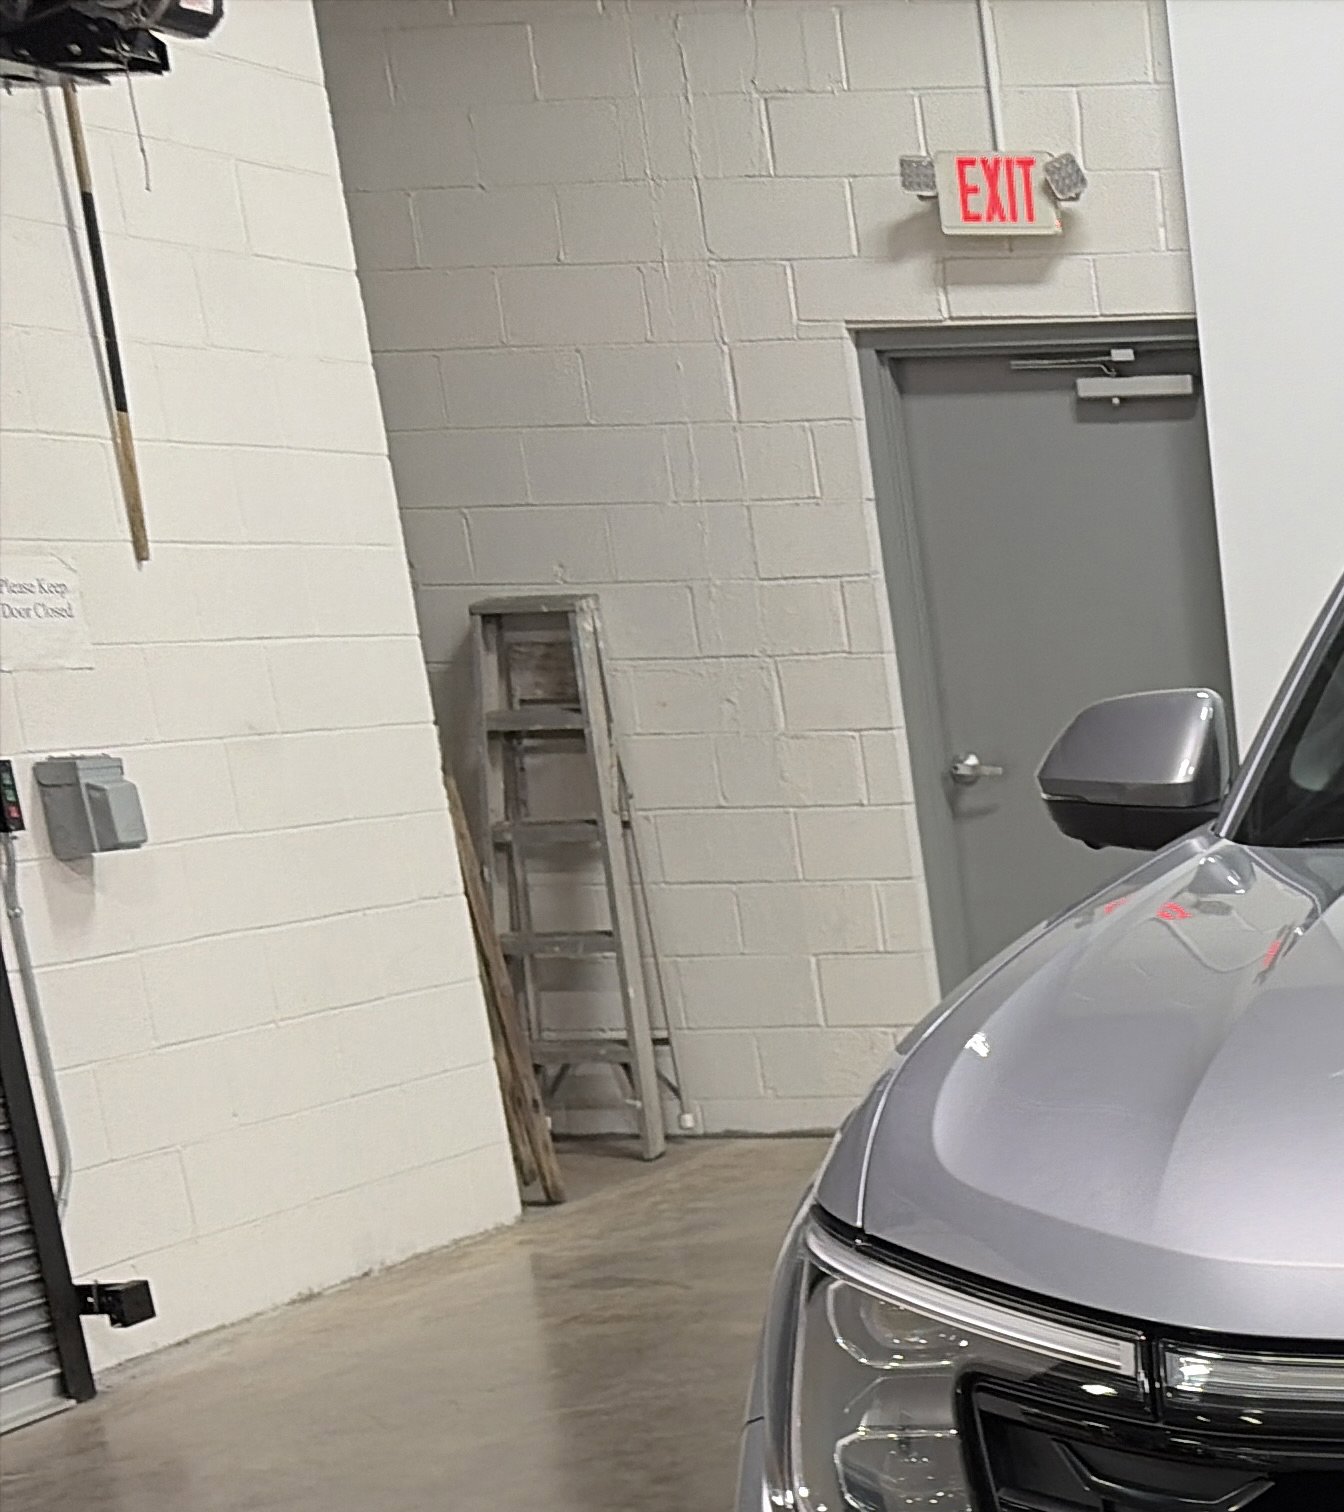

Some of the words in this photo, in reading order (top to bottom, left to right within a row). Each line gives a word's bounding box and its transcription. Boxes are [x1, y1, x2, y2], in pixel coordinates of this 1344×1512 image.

[954, 155, 1037, 224] EXIT
[0, 602, 33, 618] Door
[33, 600, 75, 618] Closed
